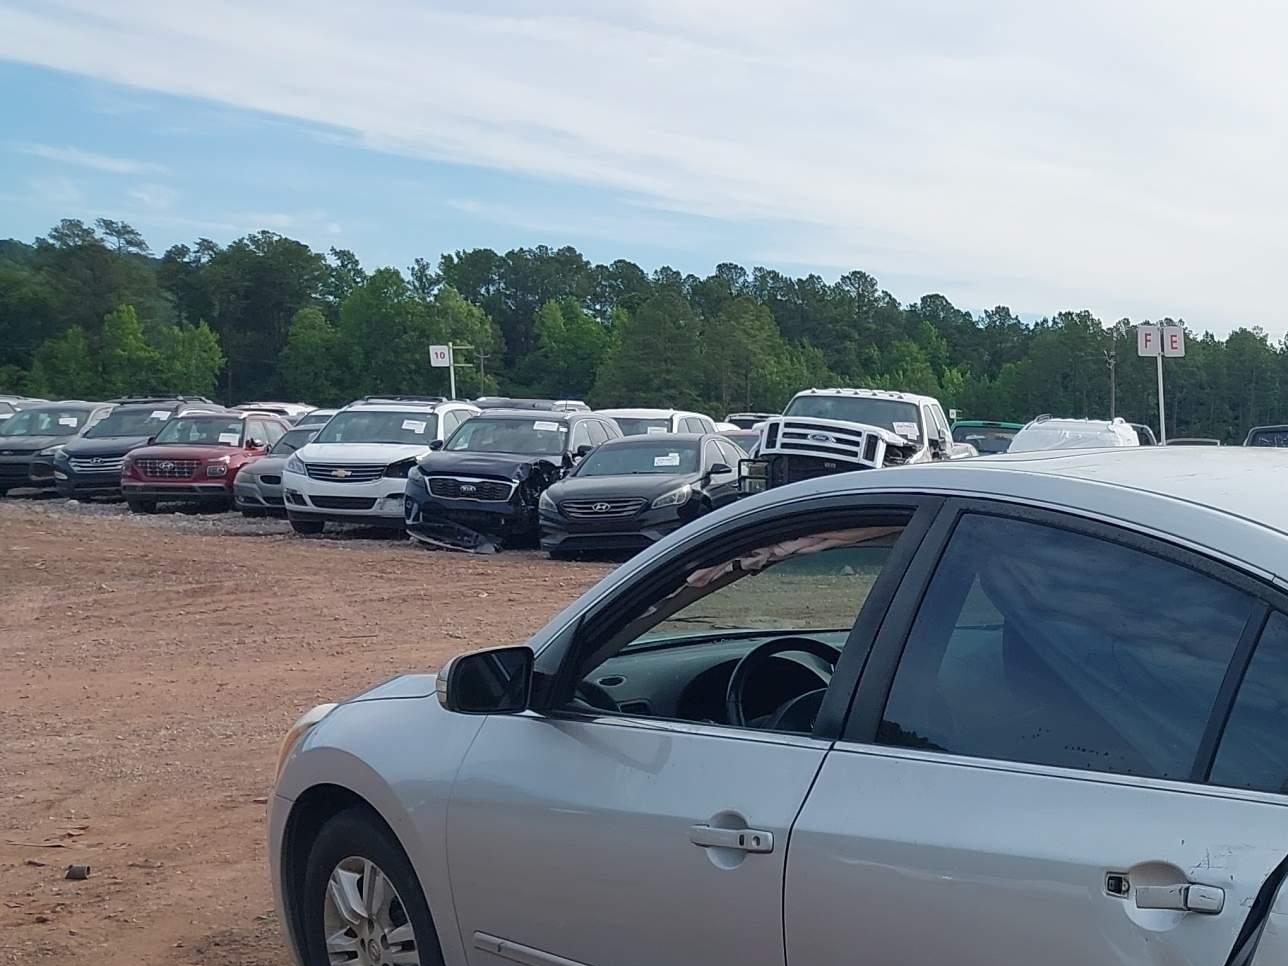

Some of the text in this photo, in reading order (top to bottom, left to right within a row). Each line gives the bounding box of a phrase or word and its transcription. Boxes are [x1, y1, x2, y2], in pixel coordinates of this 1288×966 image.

[1144, 332, 1152, 349] F
[1170, 334, 1178, 350] E
[434, 351, 446, 360] 10
